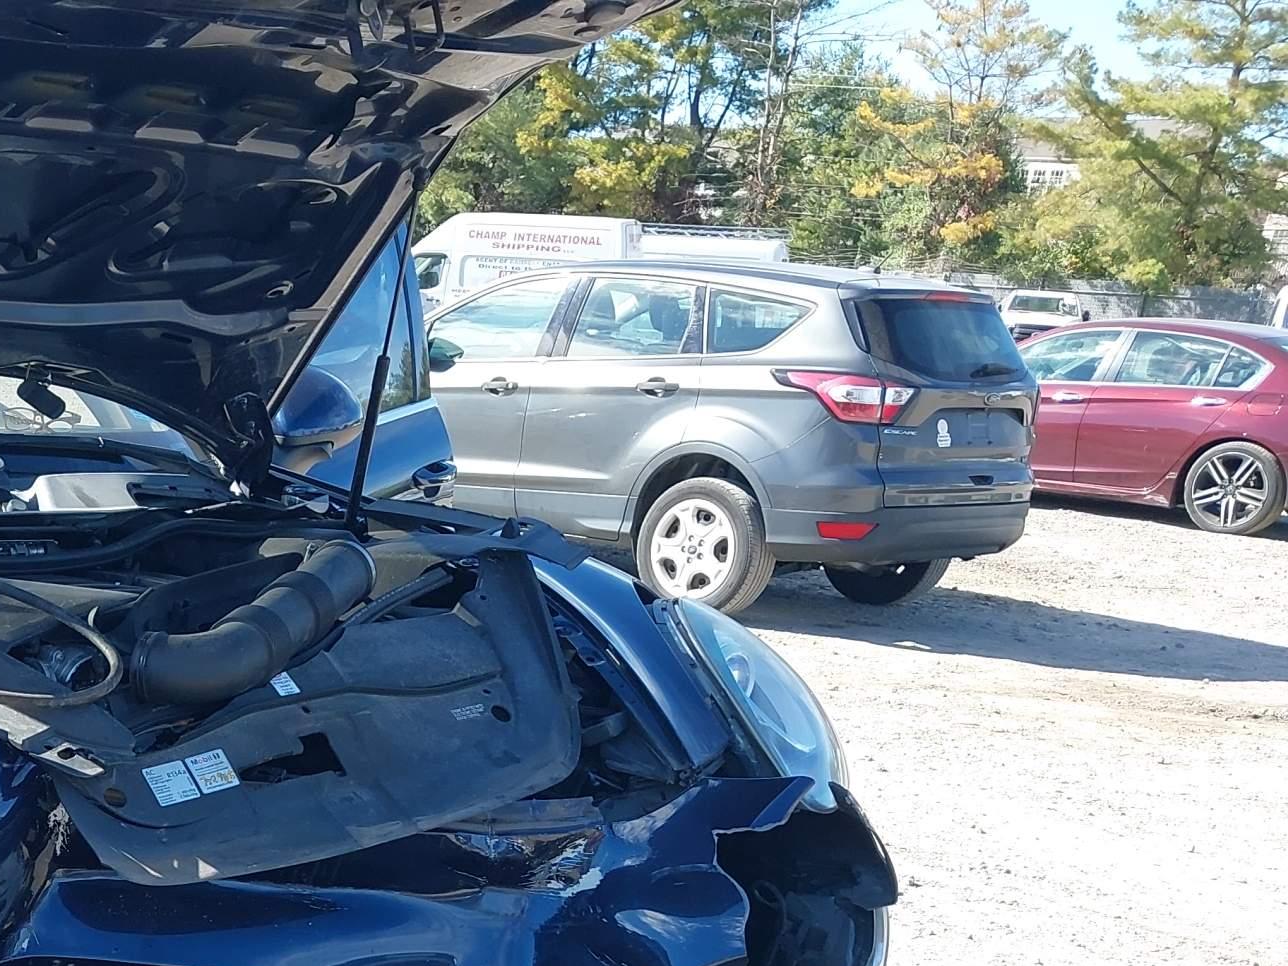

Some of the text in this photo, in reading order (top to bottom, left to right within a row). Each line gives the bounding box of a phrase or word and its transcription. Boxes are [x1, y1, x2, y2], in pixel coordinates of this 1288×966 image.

[469, 230, 602, 246] CHAMP INTERNATIONAL
[491, 242, 561, 253] SHIPPING
[190, 755, 213, 766] Mobil
